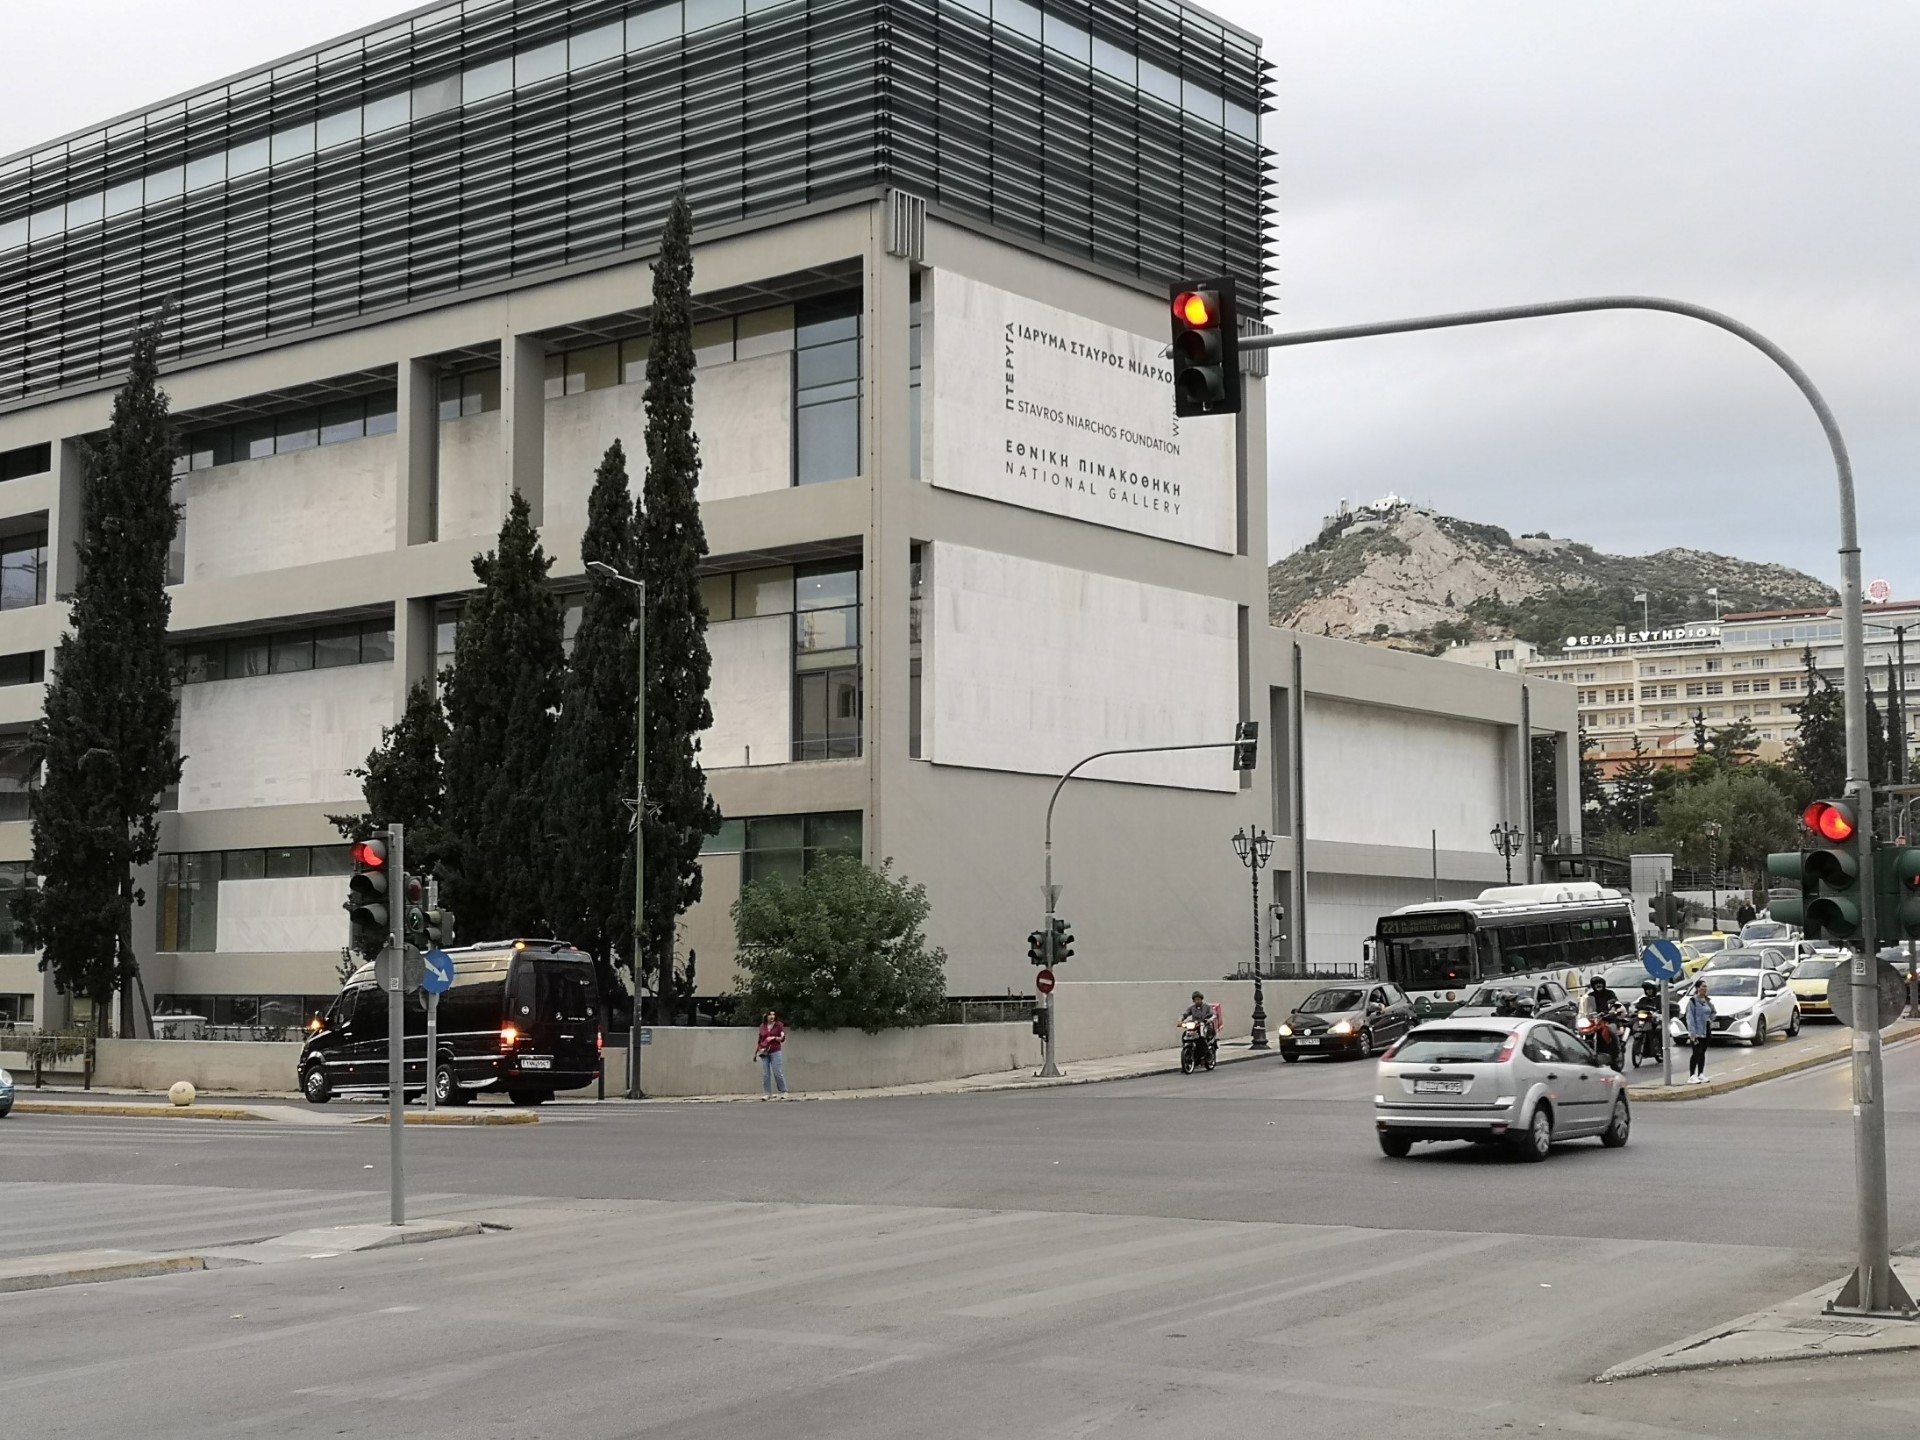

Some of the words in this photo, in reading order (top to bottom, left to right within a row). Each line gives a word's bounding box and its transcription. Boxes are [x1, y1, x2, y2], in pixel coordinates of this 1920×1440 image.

[1005, 322, 1014, 410] ΠΤΕΡΥΓΑ
[1019, 324, 1067, 352] ΙΔΡΥΜΑ
[1070, 341, 1124, 369] ΣΤΑΥΡΟΣ
[1128, 360, 1175, 385] ΝΙΑΡΧΟ
[1018, 400, 1064, 424] STAVROS
[1067, 414, 1117, 439] NIARCHOS
[1120, 429, 1180, 456] FOUNDATION
[1006, 439, 1069, 468] ΕΘΝΙΚΗ
[1079, 459, 1181, 497] ΠΙΝΑΚΟΘΗΚΗ
[1006, 461, 1096, 496] NATIONAL
[1109, 487, 1180, 516] GALLERY
[1381, 921, 1400, 934] 221
